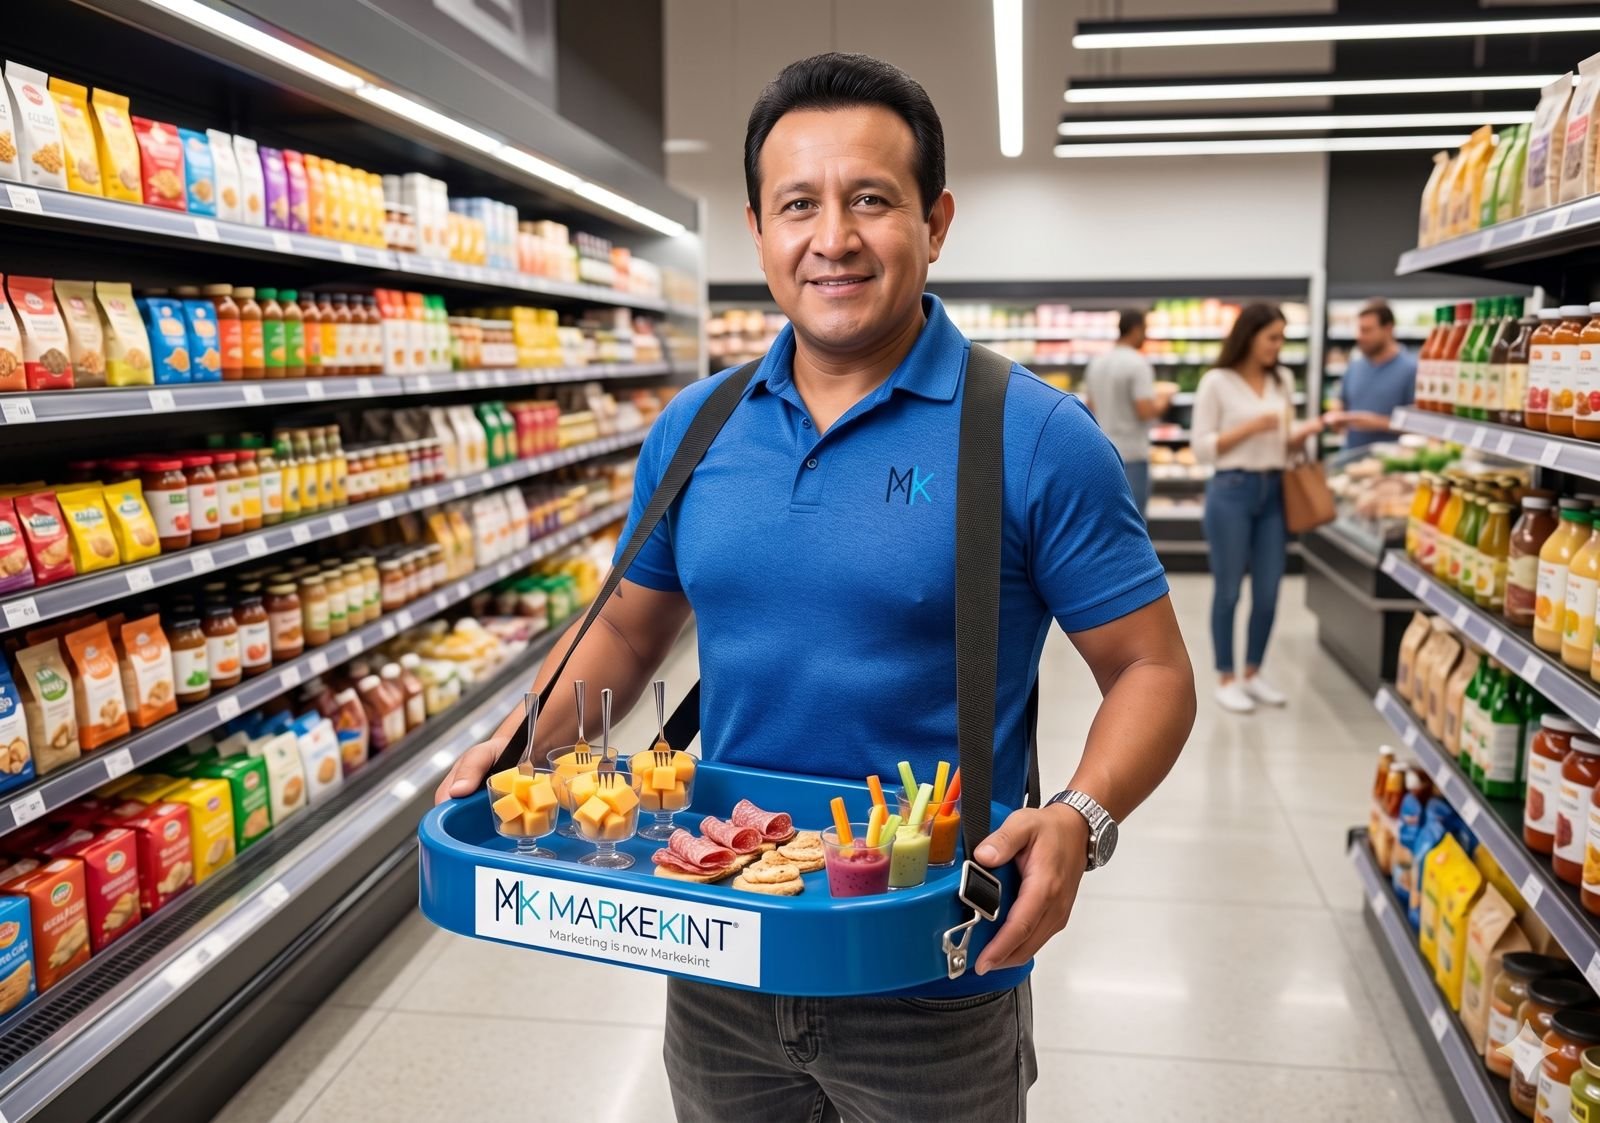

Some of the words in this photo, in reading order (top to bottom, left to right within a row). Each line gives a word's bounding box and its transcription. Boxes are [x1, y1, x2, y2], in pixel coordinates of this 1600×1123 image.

[886, 465, 934, 505] MK
[496, 878, 541, 926] MK
[549, 929, 608, 951] Marketing
[610, 939, 620, 951] is
[622, 943, 648, 957] now
[650, 947, 710, 968] Markekint
